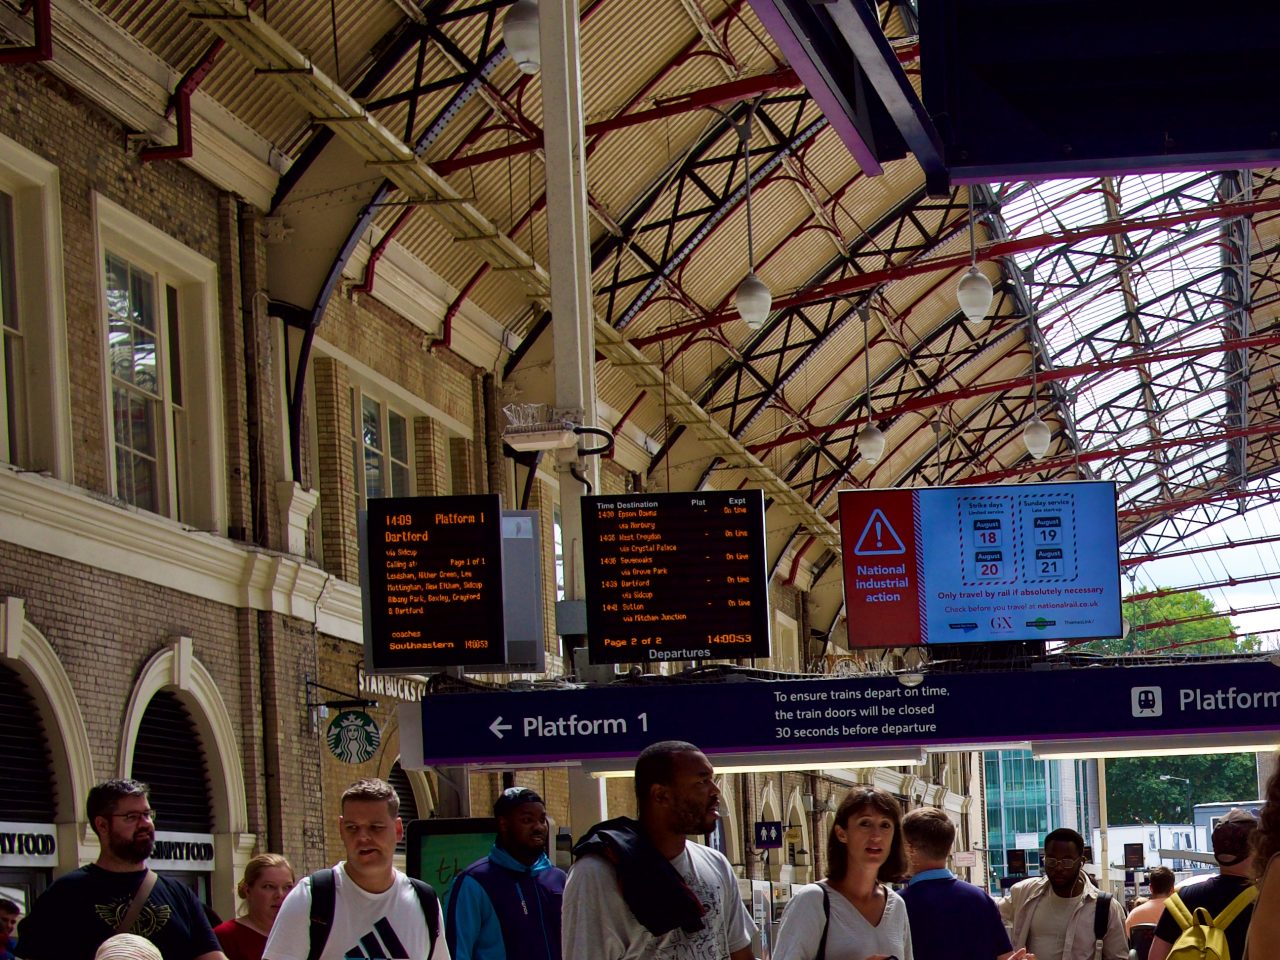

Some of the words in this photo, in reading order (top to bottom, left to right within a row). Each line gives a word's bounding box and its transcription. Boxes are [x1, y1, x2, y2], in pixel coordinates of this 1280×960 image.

[386, 515, 411, 525] 14:09
[436, 514, 475, 524] Platform
[385, 531, 428, 542] Dartford
[980, 532, 996, 543] 18
[1041, 530, 1057, 541] 19
[387, 561, 406, 569] Calling
[451, 559, 464, 567] Page
[857, 564, 905, 575] National
[981, 564, 998, 575] 20
[1042, 562, 1057, 572] 21
[856, 577, 908, 589] industrial
[866, 592, 900, 602] action
[938, 592, 956, 600] Only
[986, 591, 995, 599] by
[1020, 587, 1061, 597] absolutely
[1038, 601, 1098, 609] nationalrail.co.uk
[390, 642, 454, 650] Southeastern
[605, 639, 627, 647] Page
[708, 635, 751, 643] 14:00:53
[649, 649, 710, 660] Departures
[359, 669, 415, 701] STARBUCKS
[774, 692, 787, 702] To
[790, 692, 827, 701] ensure
[831, 690, 861, 700] trains
[864, 688, 901, 700] depart
[904, 689, 919, 697] on
[922, 687, 950, 696] time,
[775, 710, 793, 720] the
[797, 709, 821, 719] train
[825, 708, 856, 718] doors
[860, 706, 878, 716] will
[882, 706, 895, 716] be
[899, 704, 934, 715] closed
[524, 715, 626, 737] Platform
[638, 713, 648, 732] 1
[776, 727, 791, 738] 30
[794, 726, 839, 738] seconds
[843, 725, 878, 735] before
[882, 723, 936, 735] departure
[18, 833, 55, 854] FOOD
